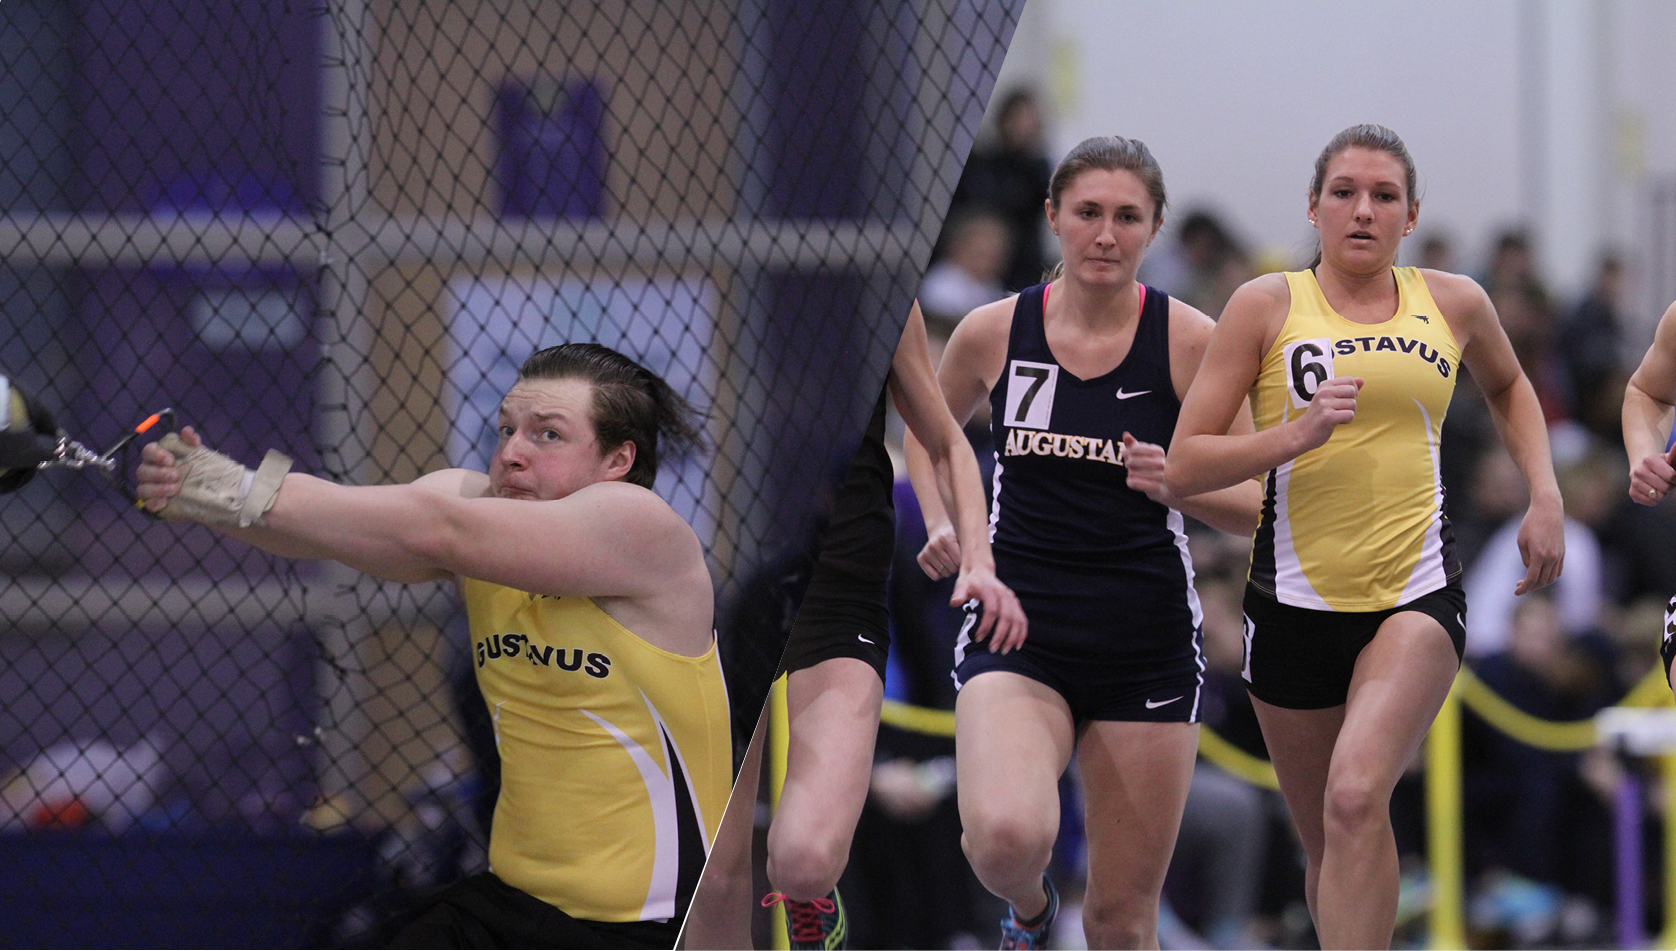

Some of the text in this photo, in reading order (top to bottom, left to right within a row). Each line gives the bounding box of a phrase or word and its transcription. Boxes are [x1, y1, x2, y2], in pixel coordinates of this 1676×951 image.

[1291, 343, 1328, 402] 6
[1331, 336, 1452, 379] STAVUS
[1014, 365, 1050, 422] 7
